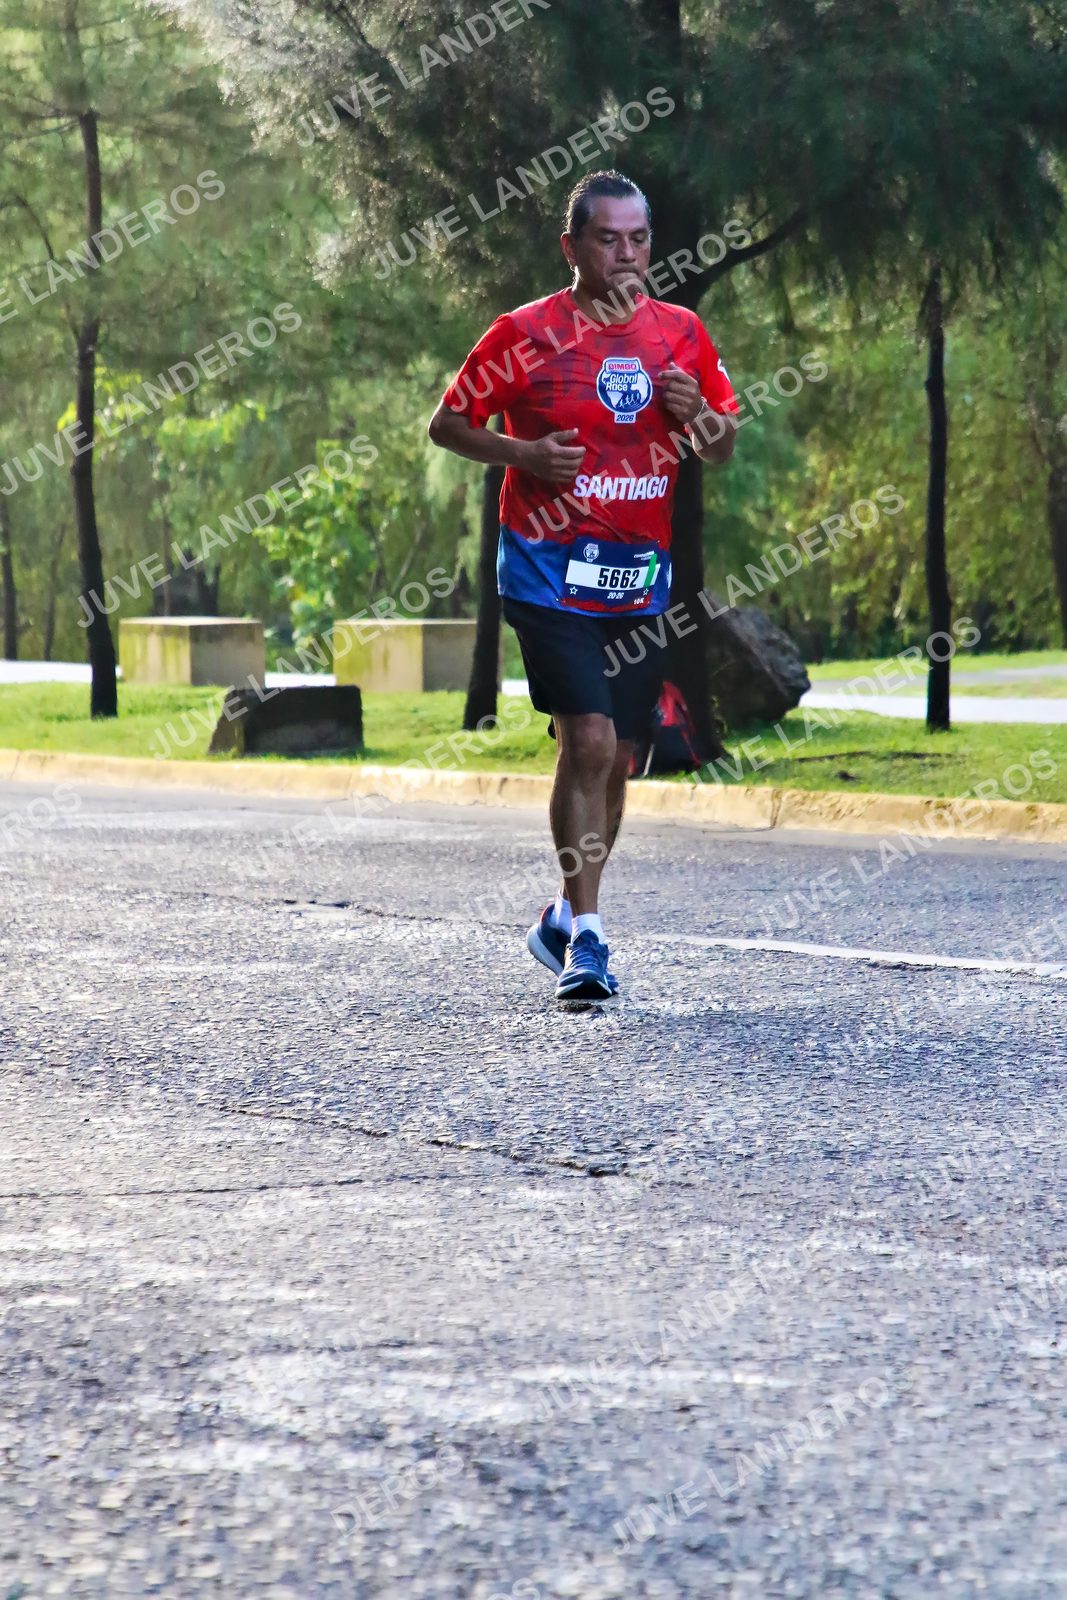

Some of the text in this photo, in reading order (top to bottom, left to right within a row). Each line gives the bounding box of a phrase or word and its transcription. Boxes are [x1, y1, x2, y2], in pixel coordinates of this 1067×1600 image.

[610, 373, 637, 384] Global
[606, 383, 628, 391] Race
[573, 474, 668, 501] SANTIAGO
[597, 567, 640, 588] 5662
